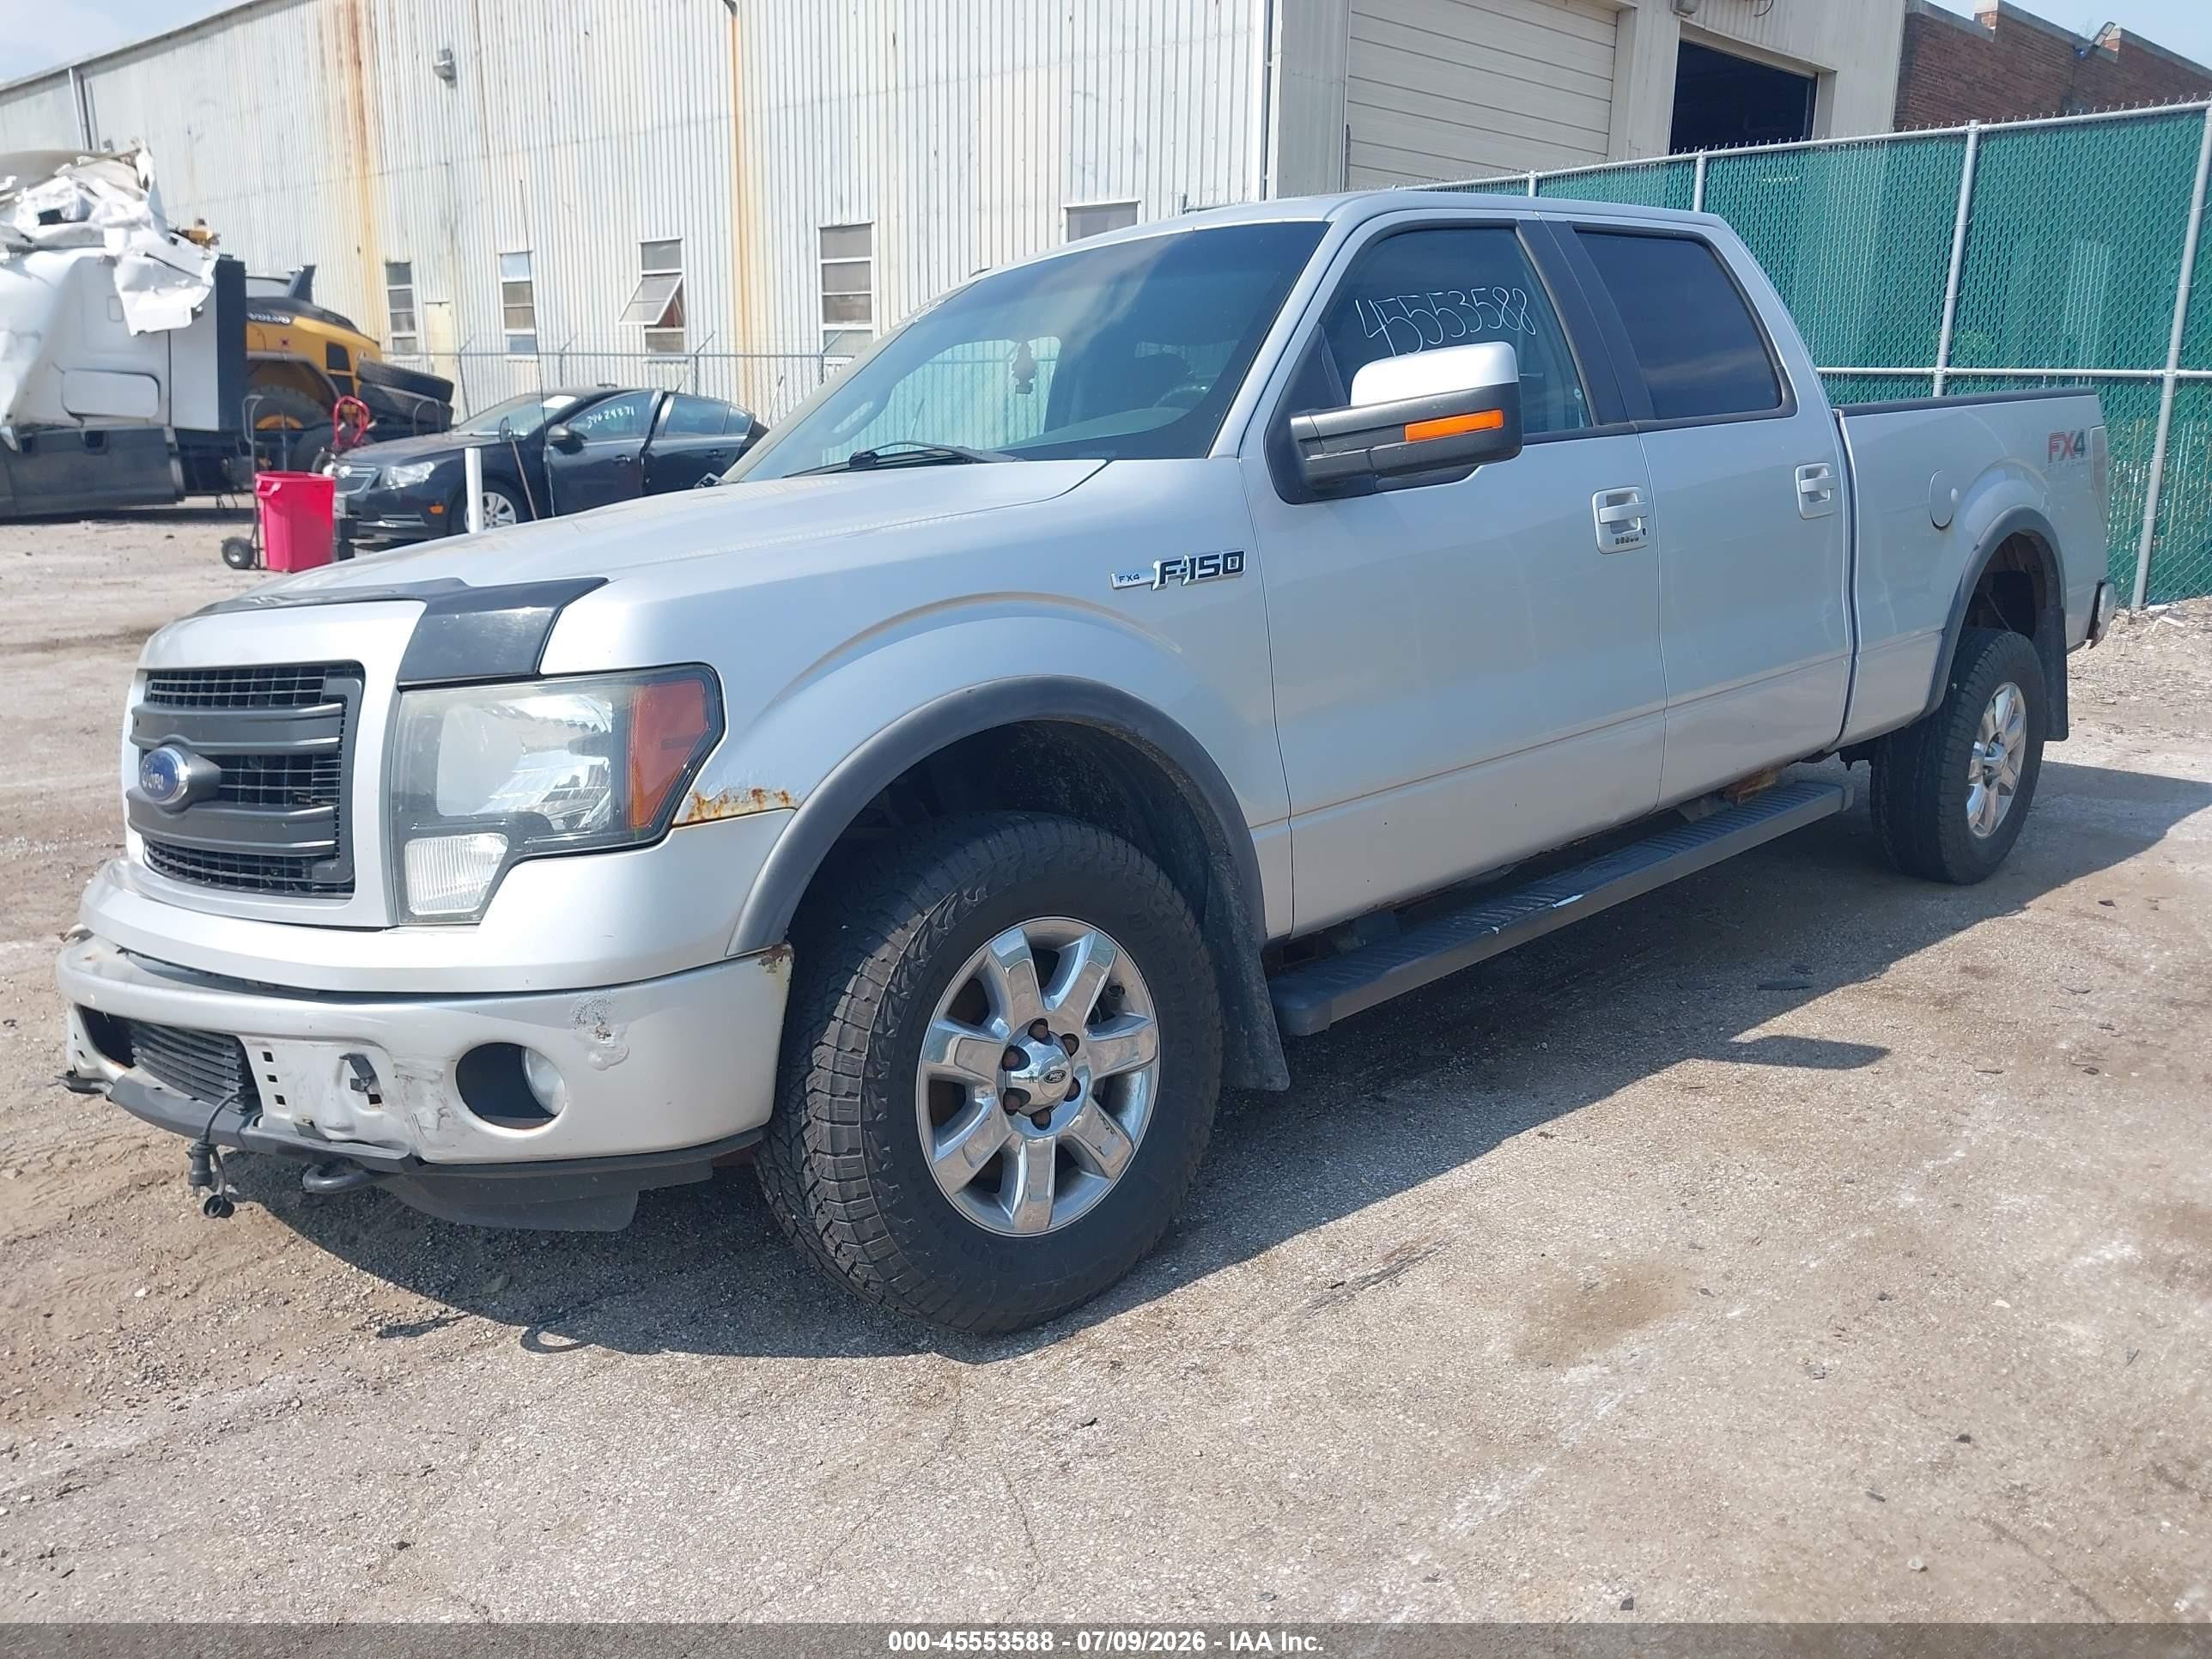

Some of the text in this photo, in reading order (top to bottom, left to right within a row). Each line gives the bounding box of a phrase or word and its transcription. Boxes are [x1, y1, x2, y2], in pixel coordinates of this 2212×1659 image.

[1353, 286, 1537, 357] 45553588
[2047, 428, 2086, 463] FX4
[1118, 549, 1246, 592] FX4 F-150
